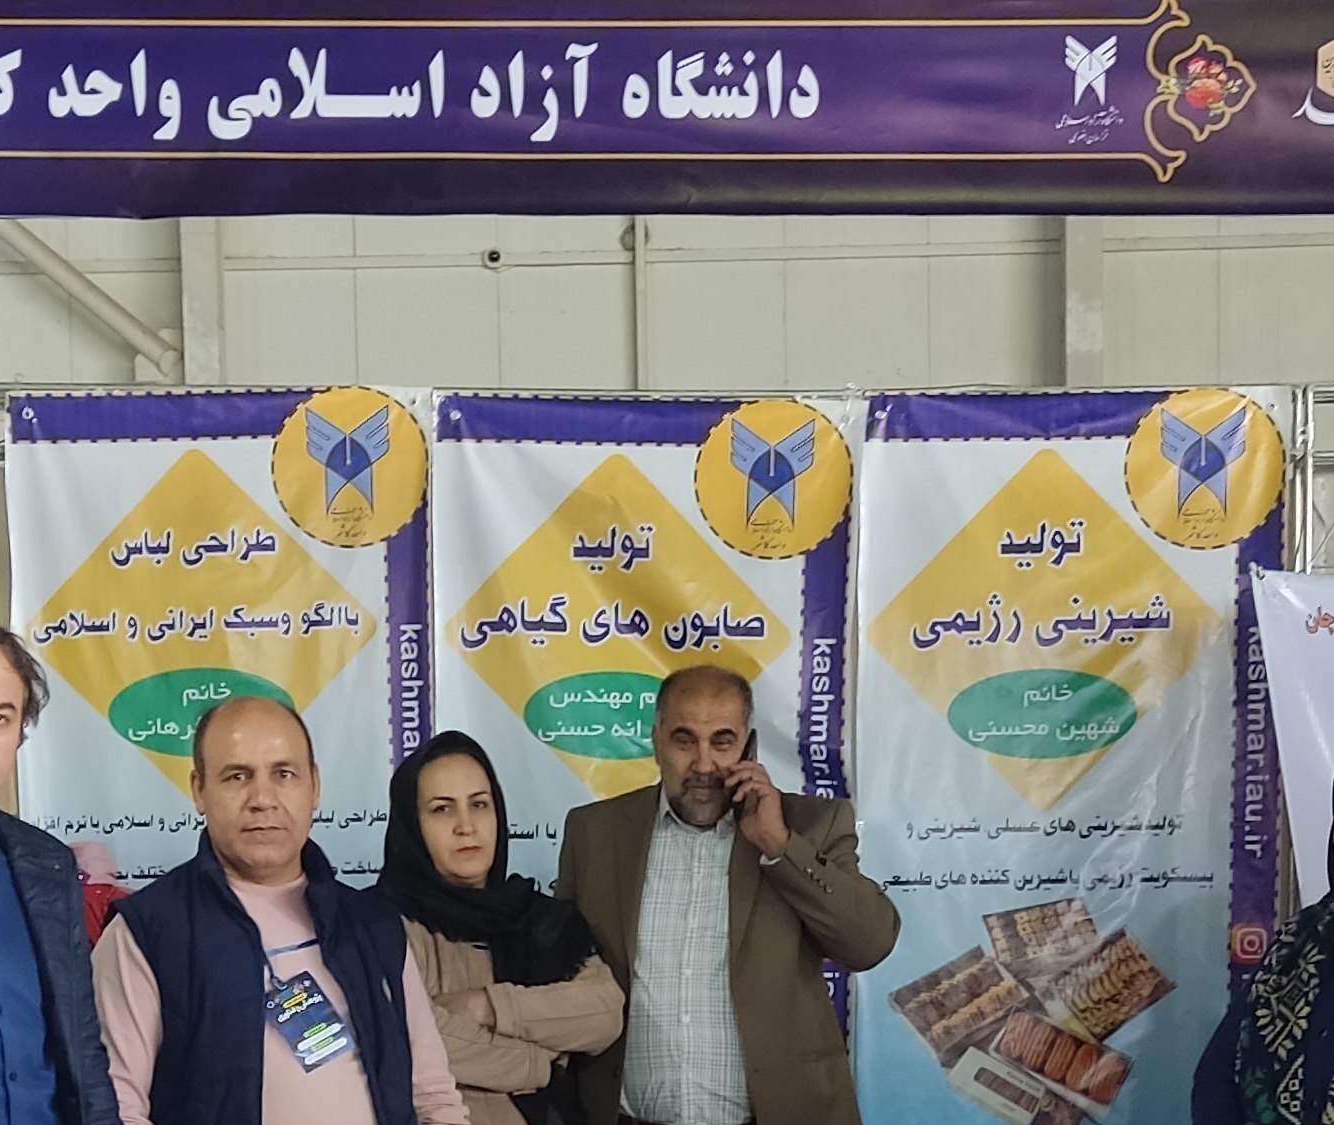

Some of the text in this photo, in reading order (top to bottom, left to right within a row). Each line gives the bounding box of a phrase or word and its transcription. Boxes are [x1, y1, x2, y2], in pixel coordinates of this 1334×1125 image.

[48, 48, 181, 140] واحد
[208, 47, 445, 140] اسلامی
[469, 42, 599, 142] آزاد
[622, 49, 820, 120] دانشگاه
[111, 530, 277, 566] طراحی لباس
[572, 526, 654, 572] تولید
[999, 520, 1083, 567] تولید
[33, 609, 214, 644] ایرانی و اسلامی
[461, 596, 765, 650] صابون های گیاهی
[913, 594, 1172, 650] شیرینی رژیمی
[183, 682, 232, 707] خانم
[549, 688, 633, 709] مهندس
[1023, 685, 1073, 708] خانم
[538, 722, 605, 743] حسنی
[968, 717, 1121, 743] شهین محسنی
[102, 814, 154, 834] اسلامی
[339, 809, 387, 829] طراحی
[918, 815, 1183, 840] تولید های عسلی شیرینی
[880, 870, 932, 892] طبیعی
[934, 868, 967, 889] های
[970, 868, 1010, 885] کننده
